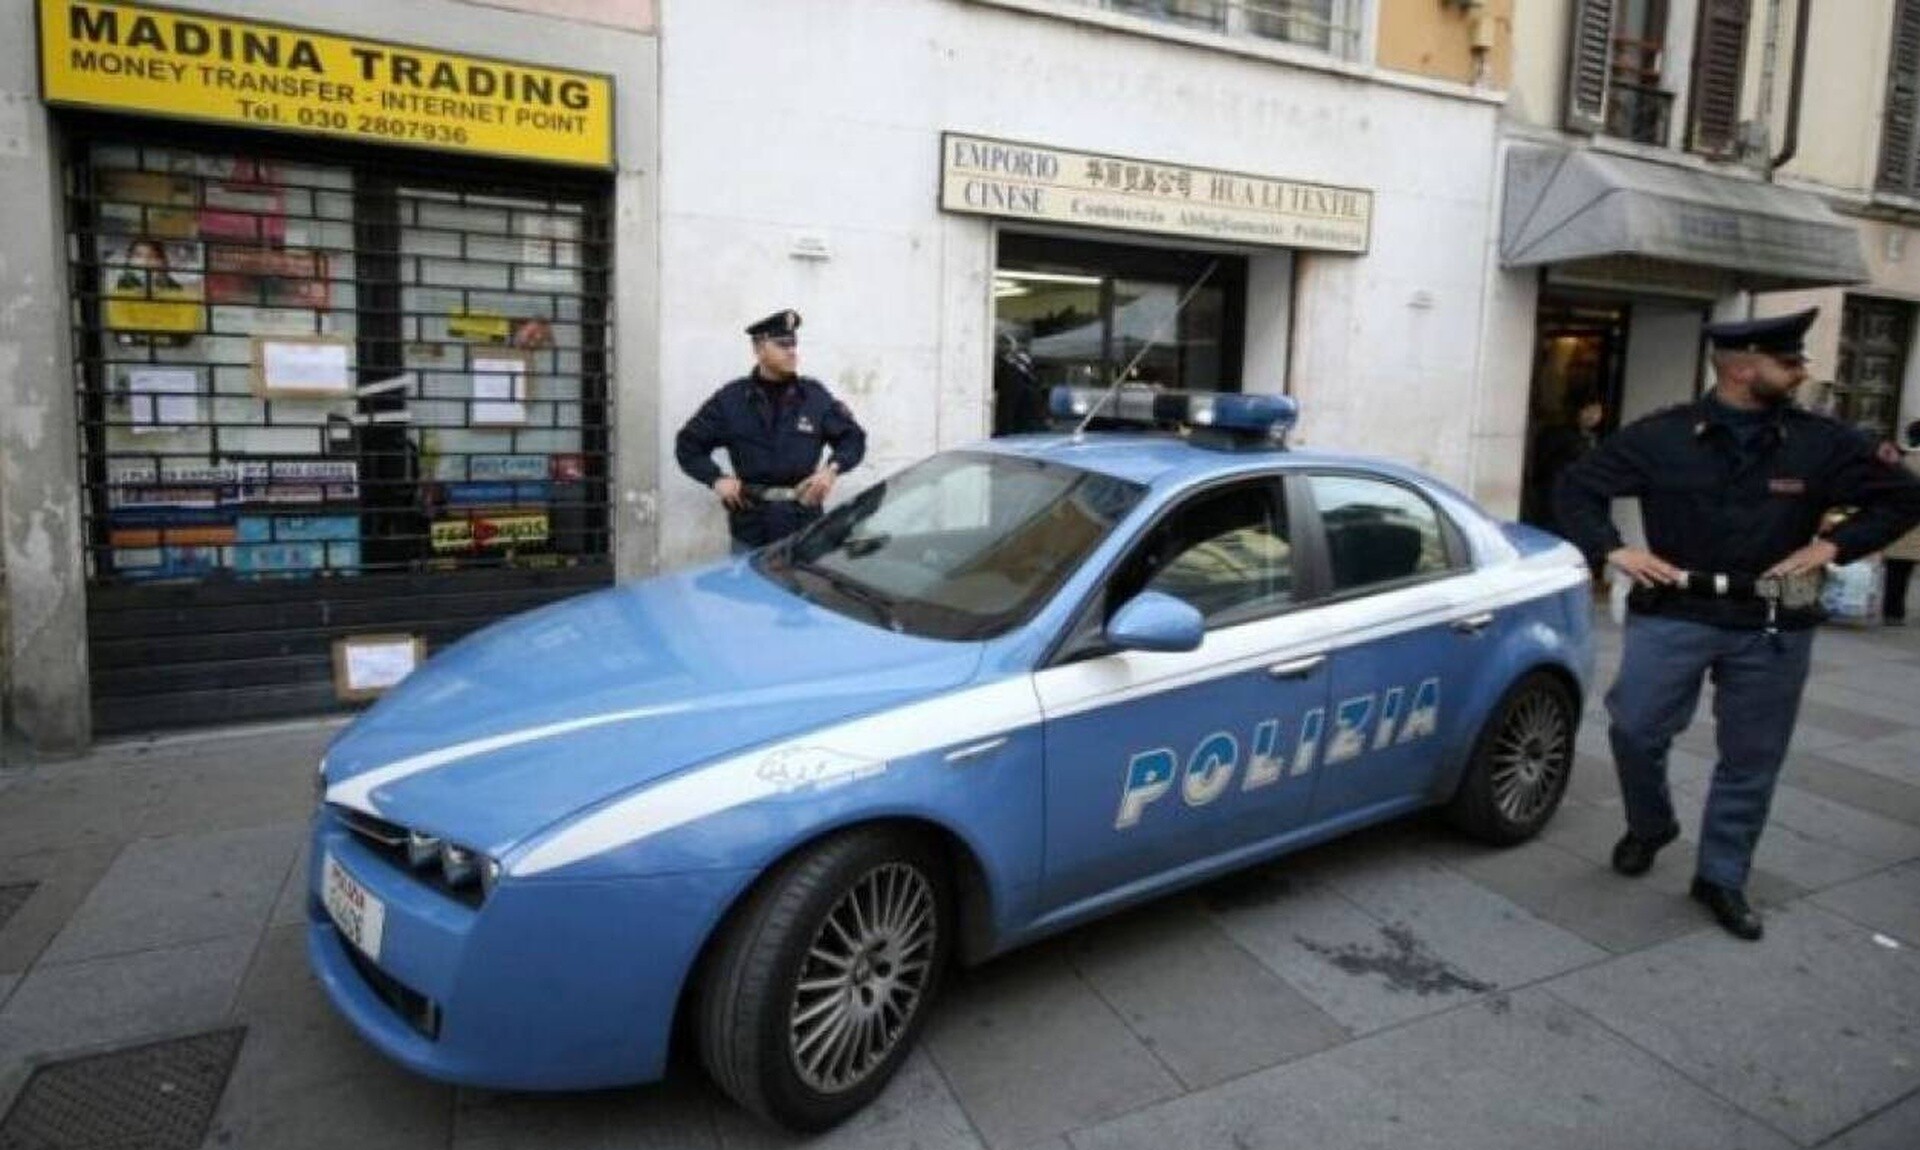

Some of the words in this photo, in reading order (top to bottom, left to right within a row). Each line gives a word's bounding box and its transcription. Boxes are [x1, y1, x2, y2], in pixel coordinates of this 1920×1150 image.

[70, 5, 324, 74] MADINA
[350, 47, 590, 110] TRADING
[71, 48, 188, 83] MONEY
[197, 65, 355, 105] TRANSFER
[381, 89, 508, 125] INTERNET
[516, 106, 586, 135] POINT
[239, 99, 288, 123] Tel.
[297, 106, 348, 131] 030
[358, 115, 469, 145] 2807936
[954, 141, 1059, 180] EMPORIO
[963, 181, 1045, 214] CINESE
[1210, 174, 1255, 207] HUA
[1114, 676, 1441, 831] POLIZIA
